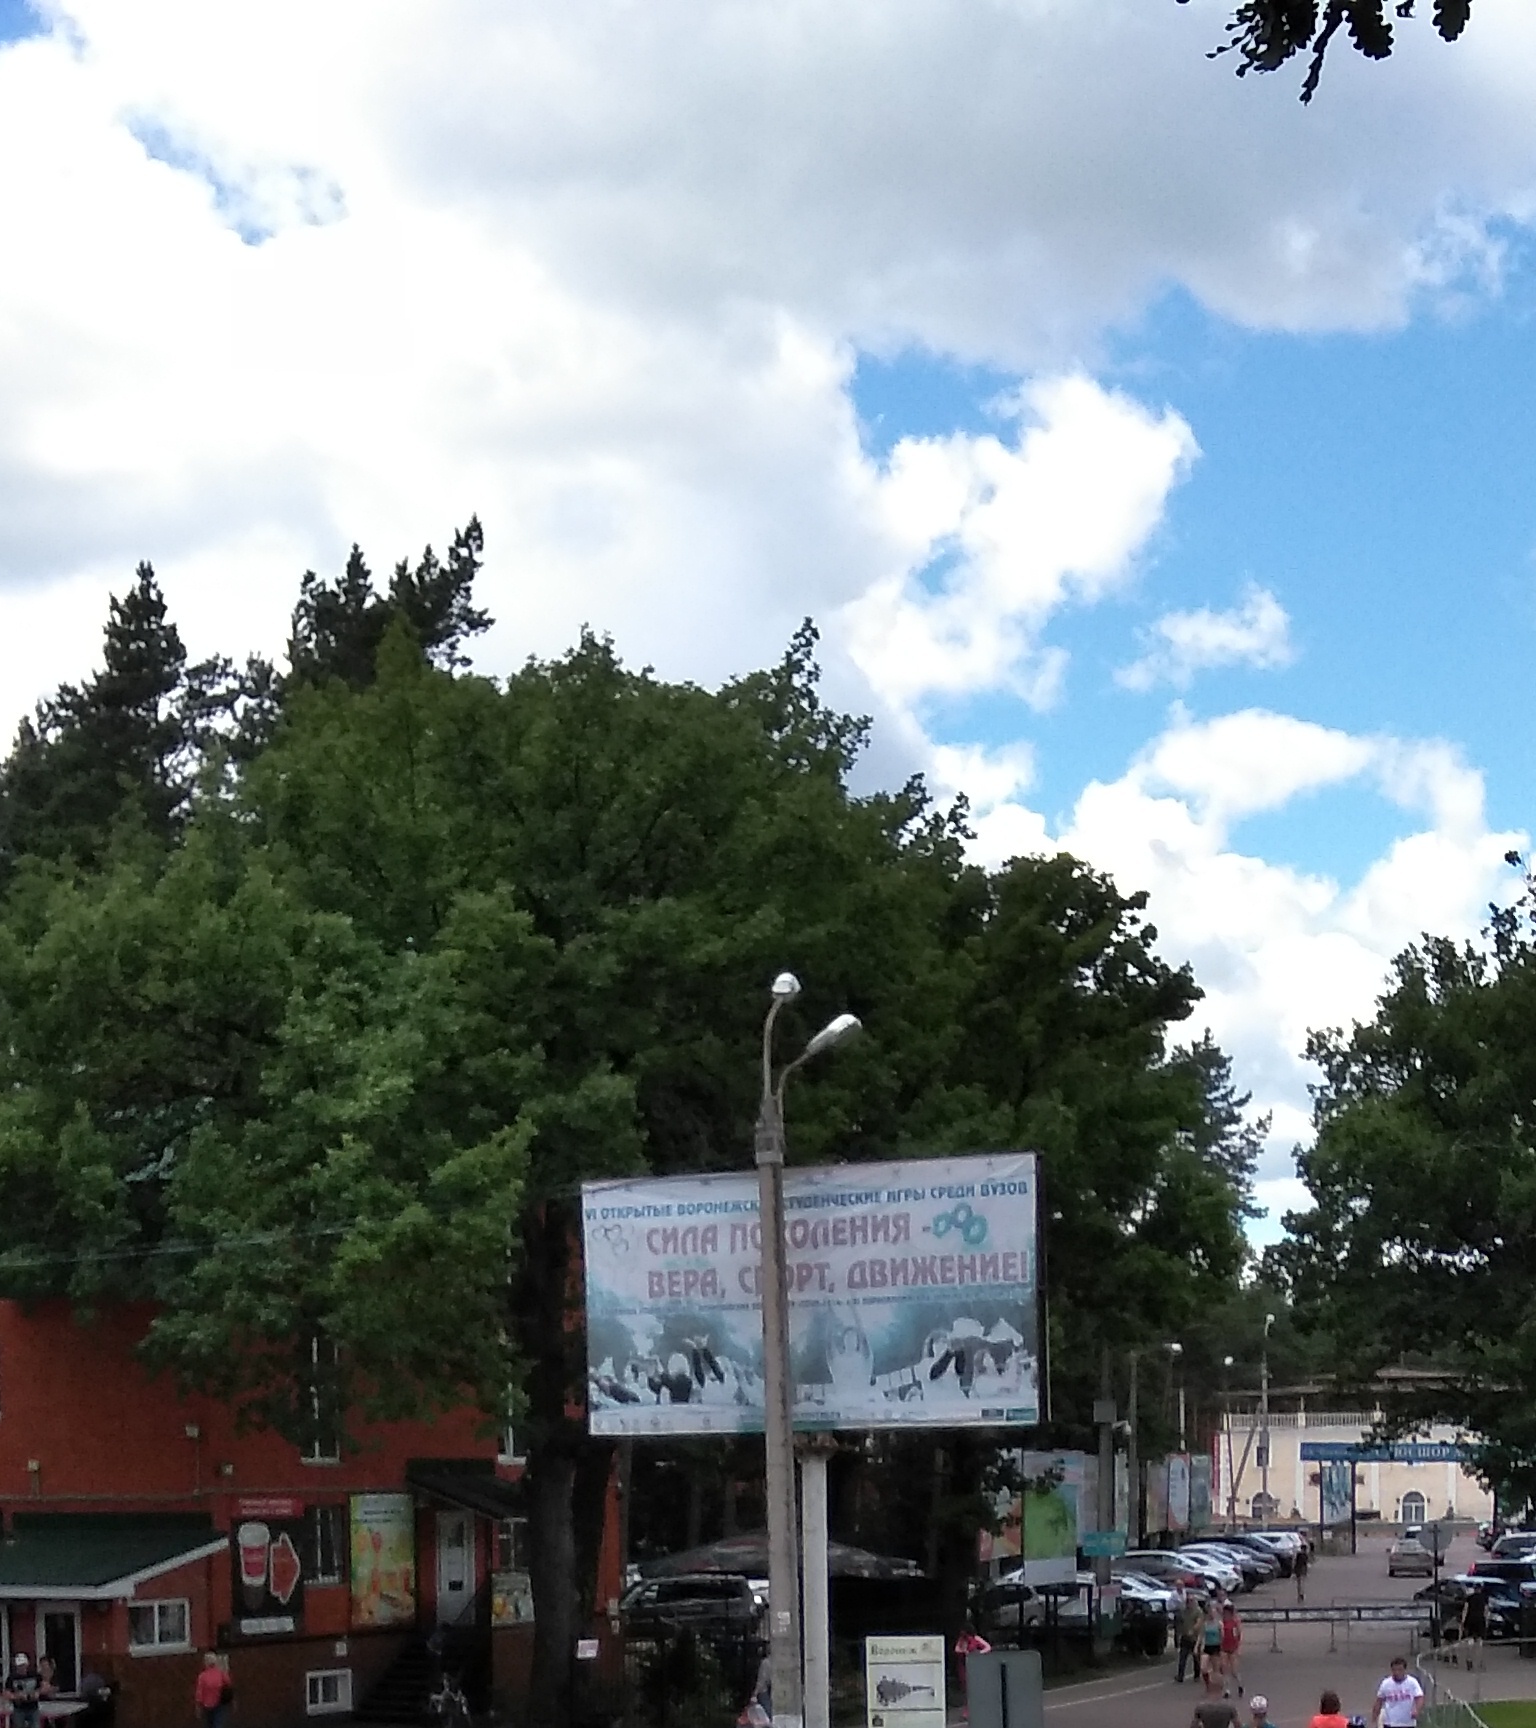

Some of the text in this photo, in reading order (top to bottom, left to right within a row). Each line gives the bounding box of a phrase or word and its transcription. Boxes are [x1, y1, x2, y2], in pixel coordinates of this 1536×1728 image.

[600, 1203, 672, 1220] ОТКРЫТЫЕ
[677, 1200, 760, 1216] ВОРОНЕЖСК
[784, 1191, 882, 1210] ТУДЕНЧЕСКИЕ
[887, 1188, 926, 1203] ИГРЫ
[930, 1185, 975, 1199] СРЕДИ
[980, 1181, 1028, 1197] ВУЗОВ
[646, 1223, 719, 1256] СИЛА
[730, 1212, 911, 1254] ПООЛЕНИЯ
[648, 1267, 726, 1299] ВЕРА,
[847, 1251, 1030, 1290] ДВИЖЕНИЕ!
